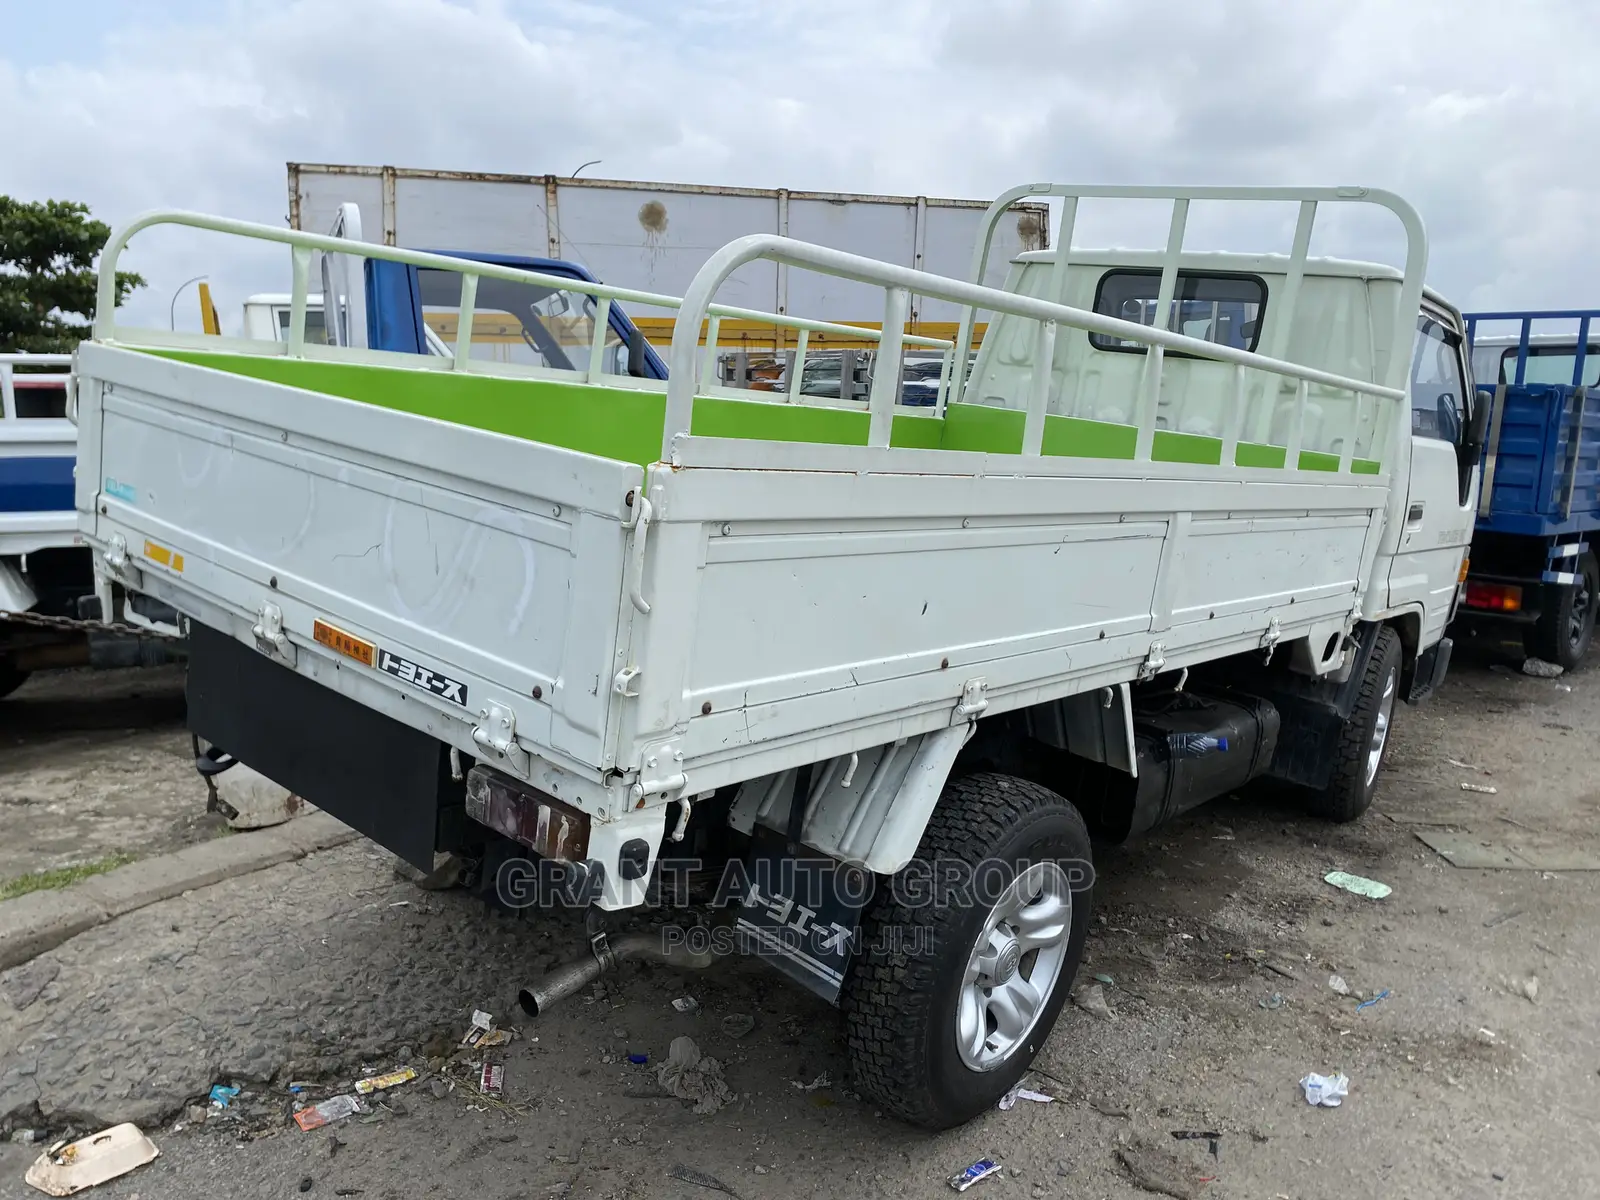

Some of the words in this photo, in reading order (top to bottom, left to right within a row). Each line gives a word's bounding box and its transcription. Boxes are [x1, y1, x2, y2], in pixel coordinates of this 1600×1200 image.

[380, 652, 463, 704] トヨエース
[744, 883, 853, 957] トヨエース
